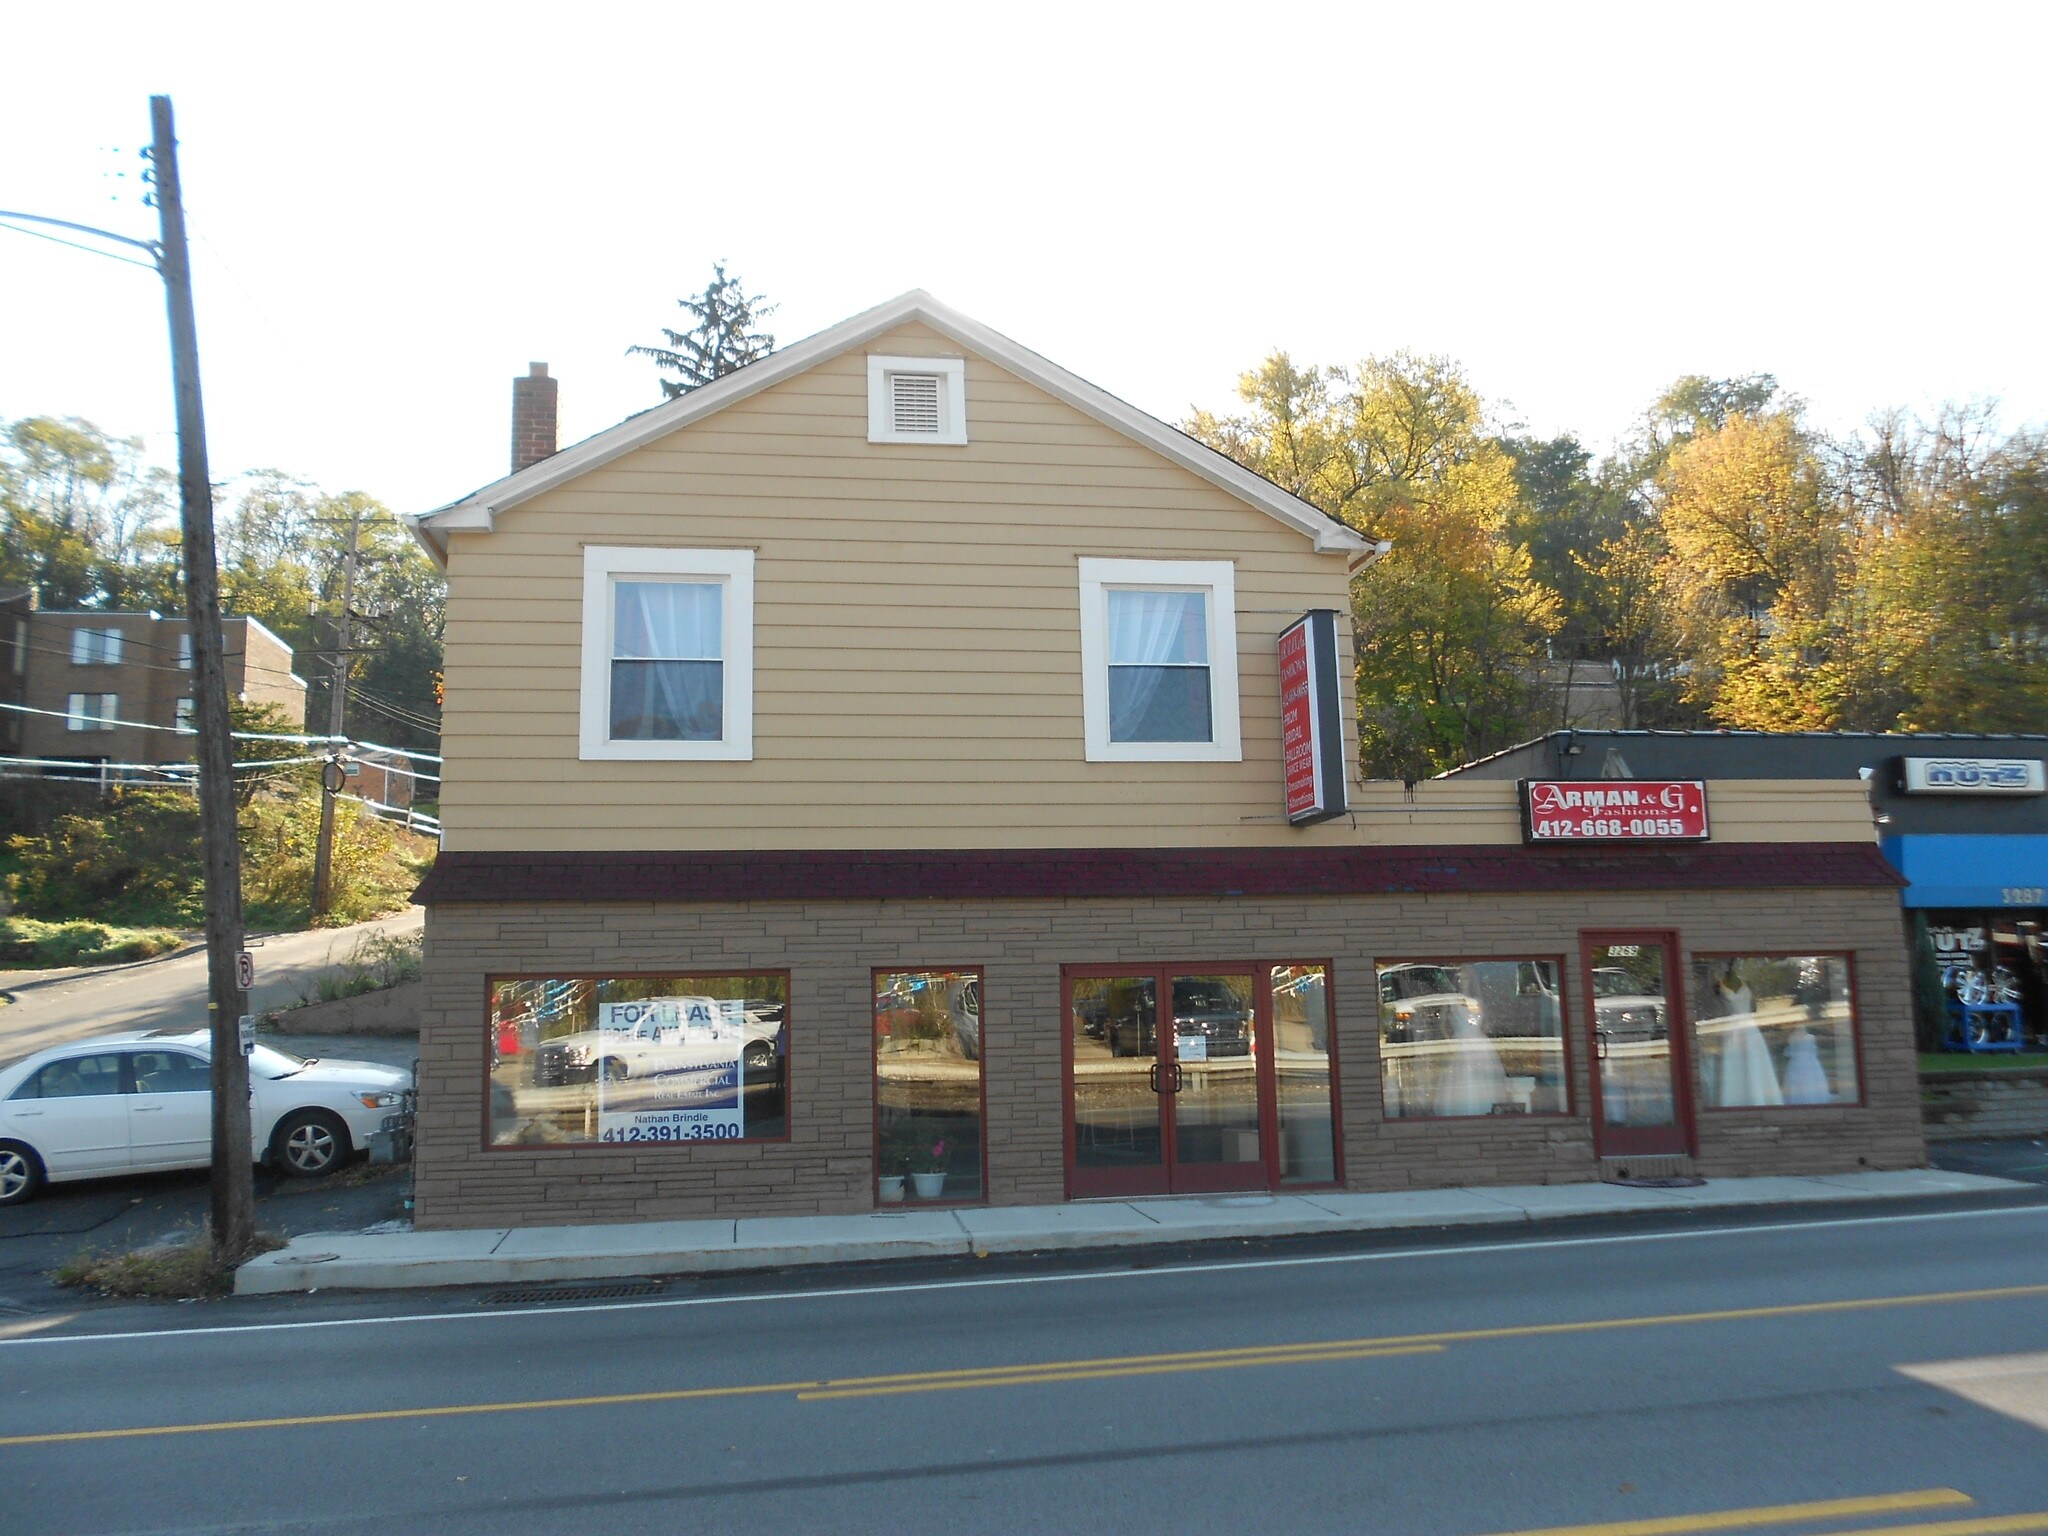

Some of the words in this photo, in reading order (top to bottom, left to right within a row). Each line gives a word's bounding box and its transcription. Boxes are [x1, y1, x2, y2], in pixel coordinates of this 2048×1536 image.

[1533, 785, 1638, 814] ARMAN
[1641, 794, 1657, 805] &
[1538, 819, 1684, 837] 412-668-0055
[1610, 946, 1638, 956] 3269
[634, 1114, 670, 1124] Nathan
[672, 1112, 709, 1122] Brindle
[602, 1122, 740, 1142] 412-391-3500
